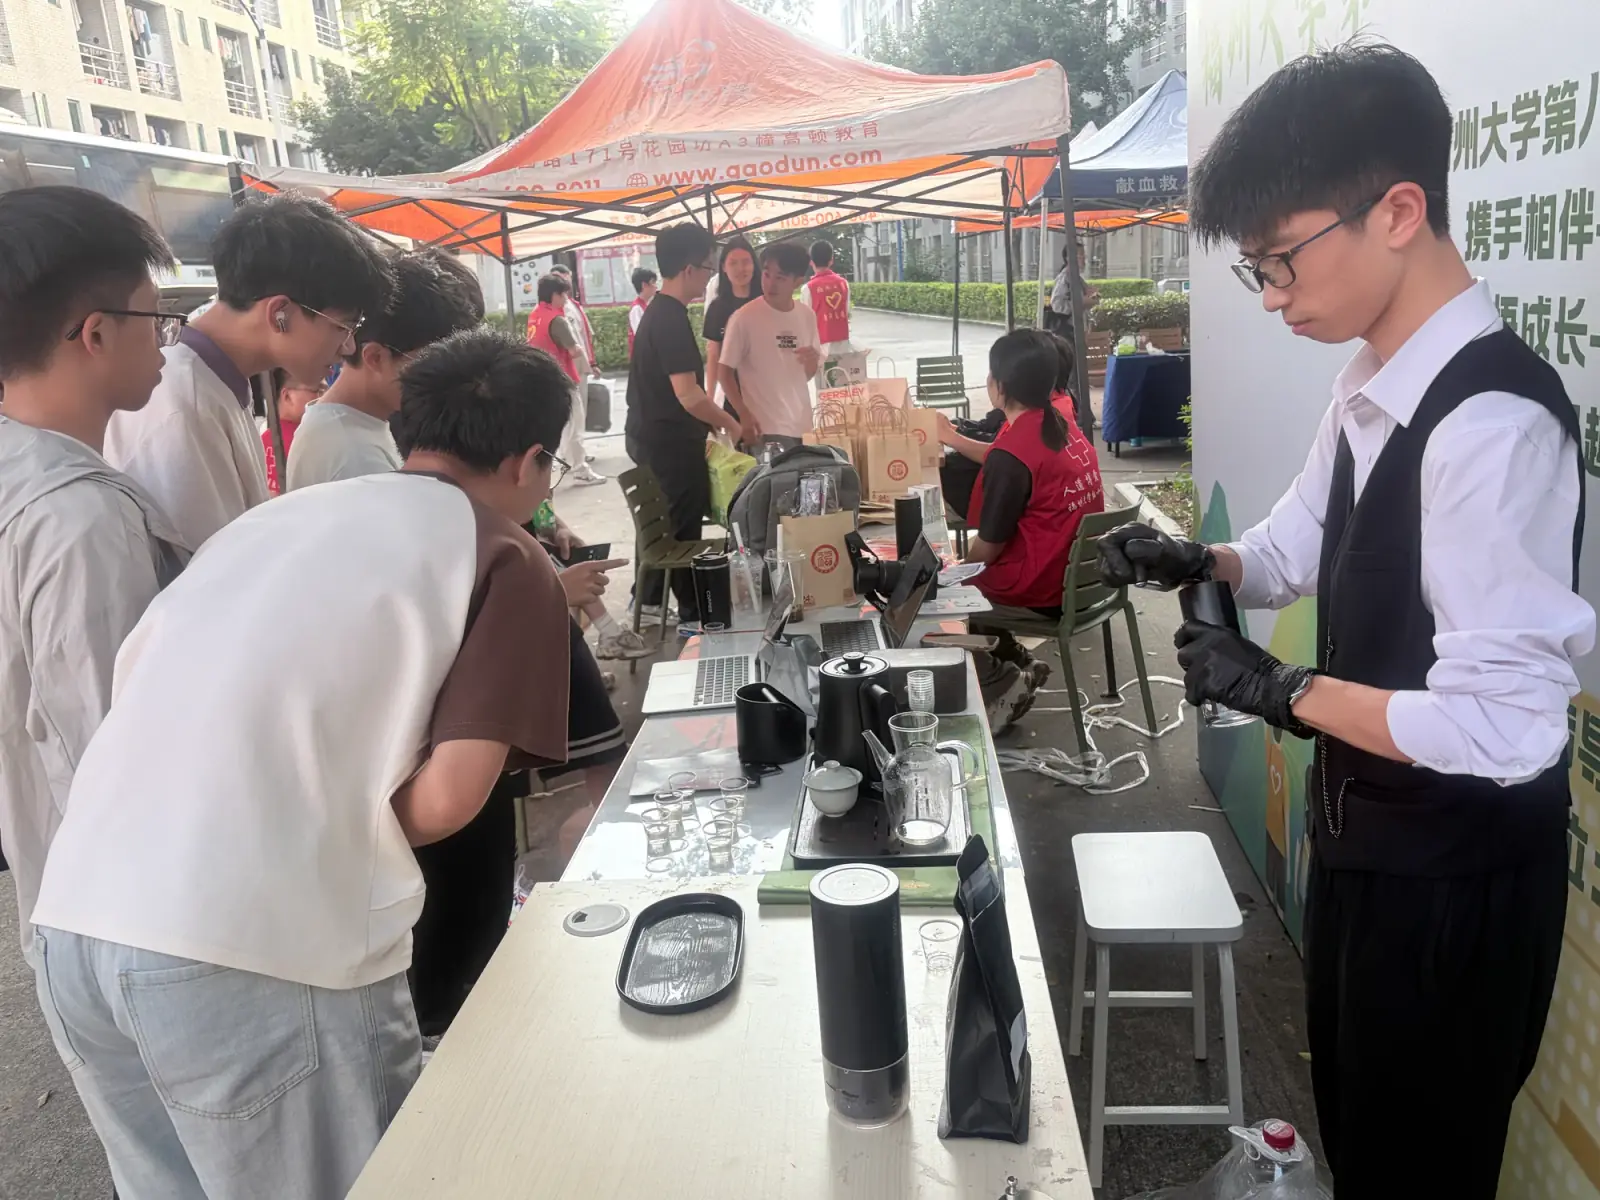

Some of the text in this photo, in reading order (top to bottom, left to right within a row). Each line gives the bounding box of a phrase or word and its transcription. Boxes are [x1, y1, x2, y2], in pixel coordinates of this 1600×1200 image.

[1115, 174, 1187, 194] 献血救
[1464, 187, 1600, 262] 携手相伴
